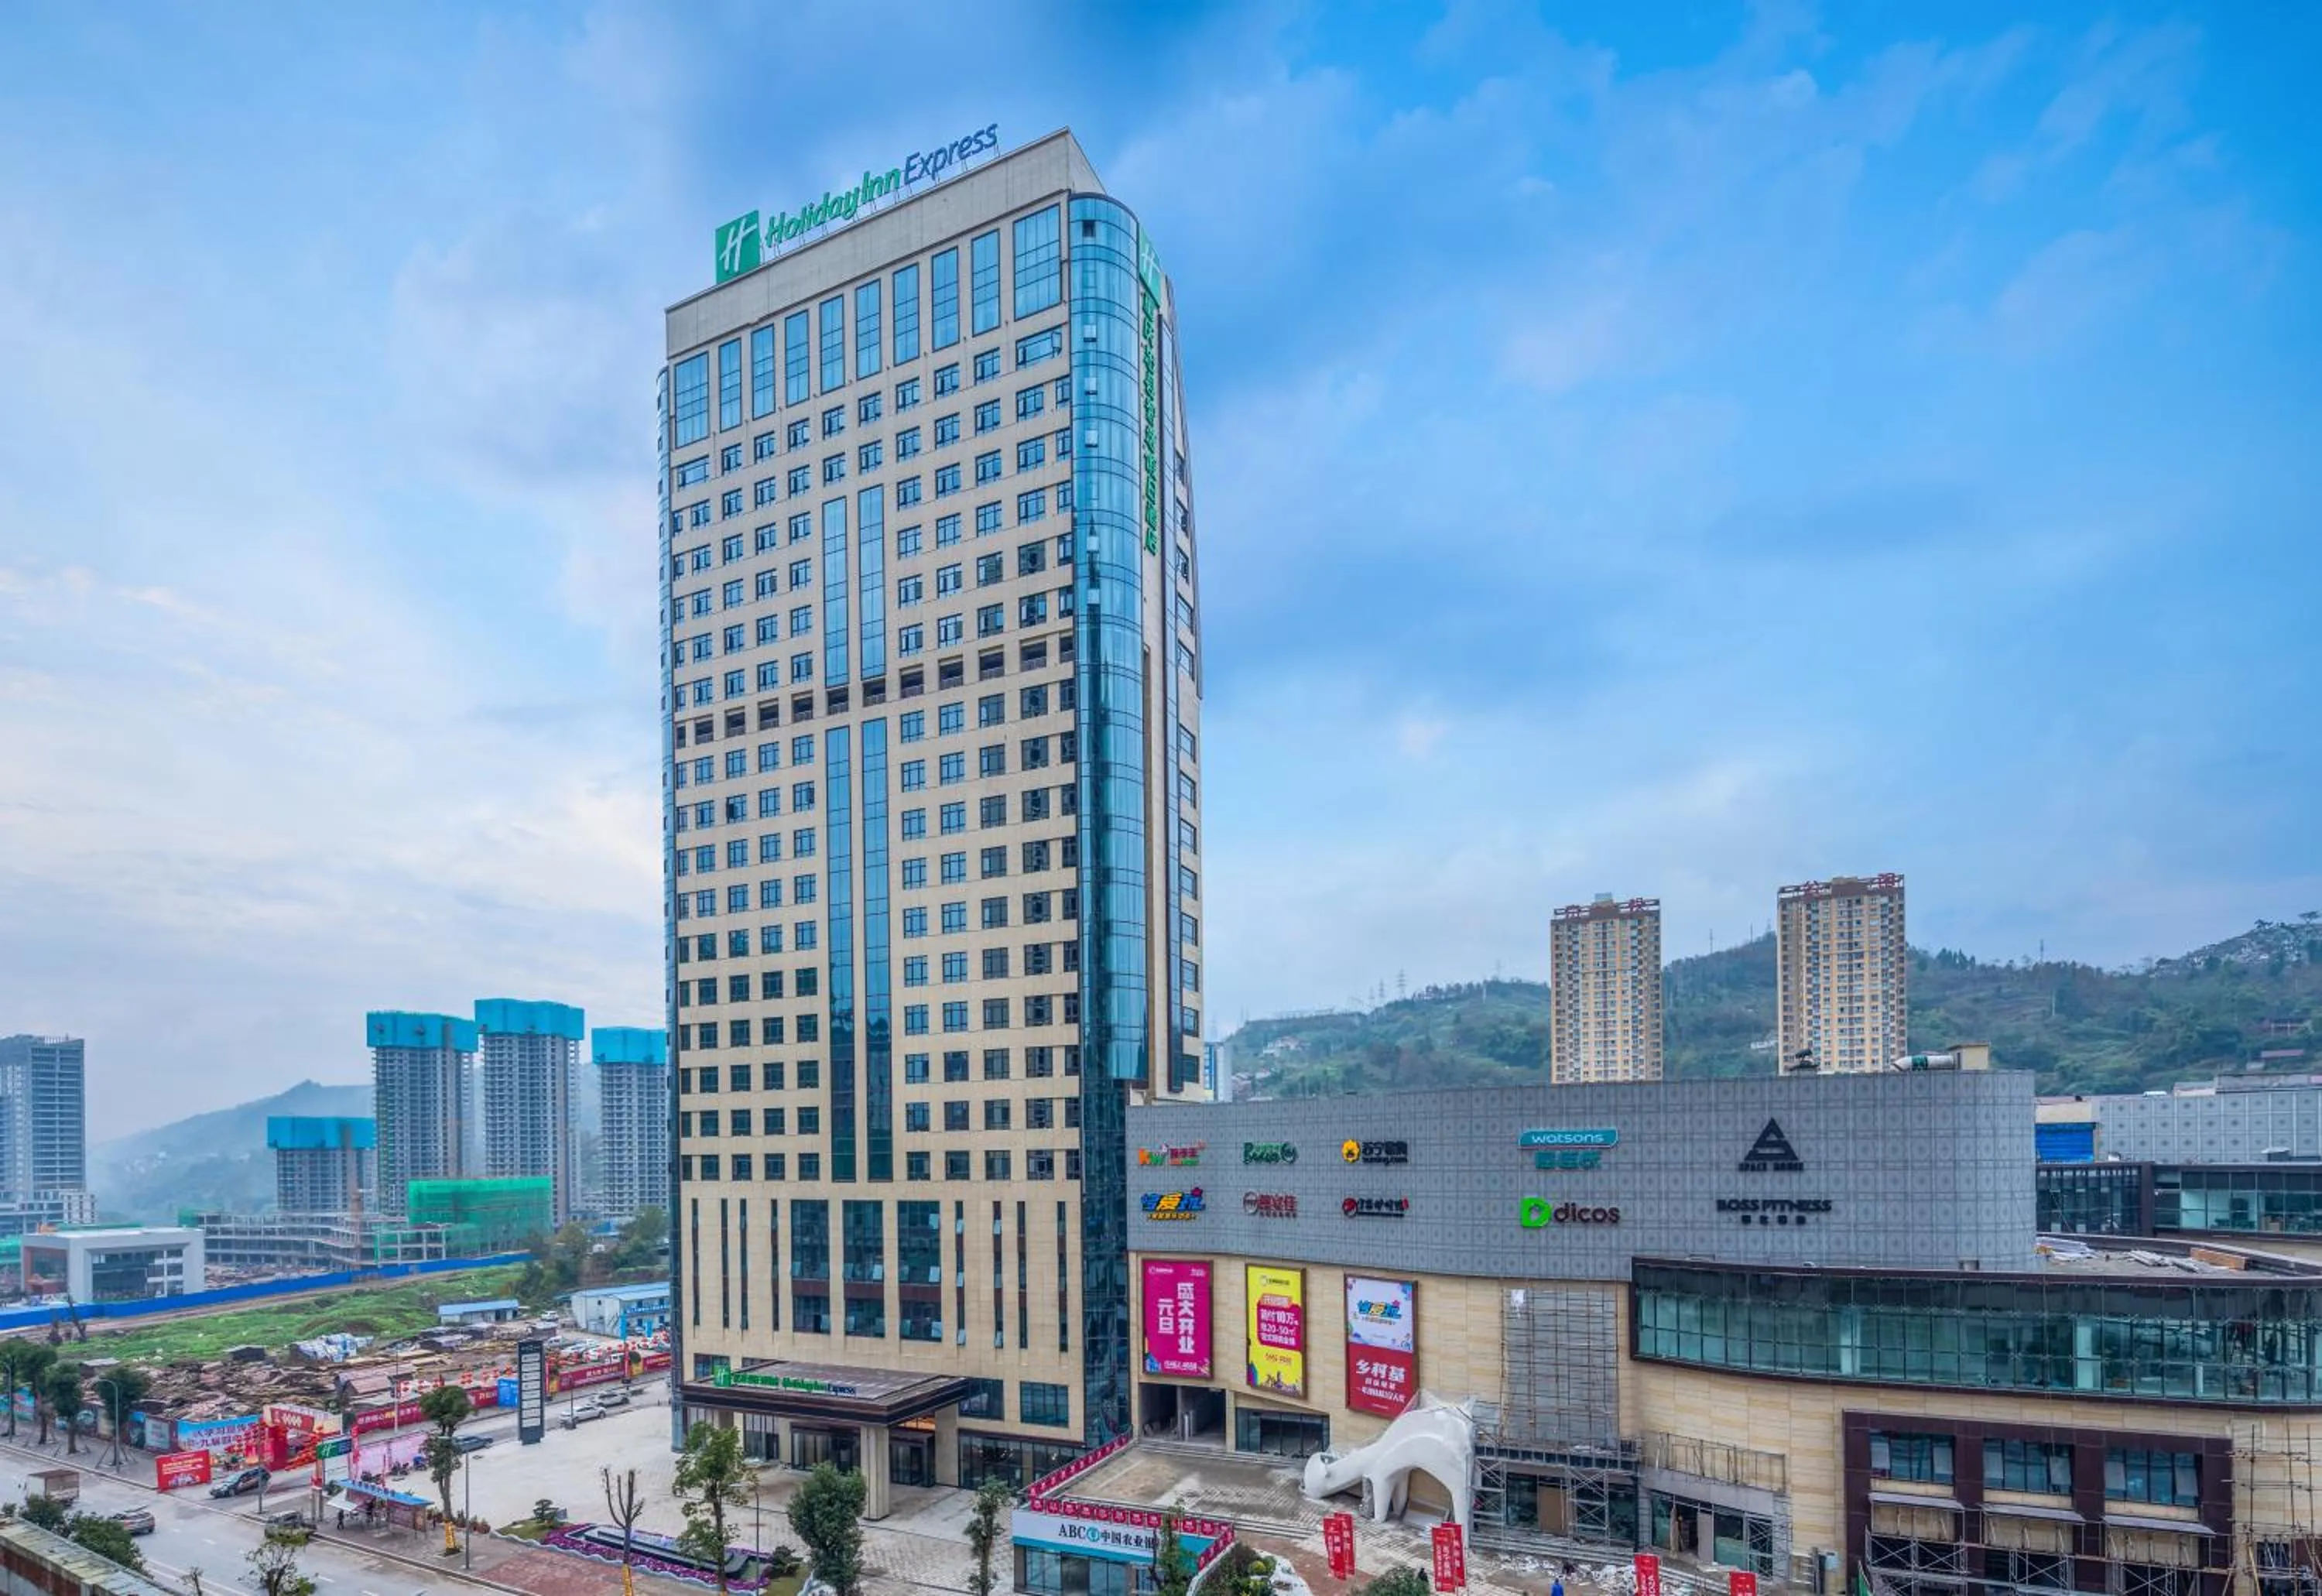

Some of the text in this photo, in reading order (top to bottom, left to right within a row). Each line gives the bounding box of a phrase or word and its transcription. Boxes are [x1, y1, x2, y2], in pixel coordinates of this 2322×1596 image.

[904, 123, 998, 186] Express
[1532, 1133, 1605, 1143] watsons
[1553, 1202, 1620, 1223] dicos
[1717, 1200, 1759, 1211] BOSS
[1157, 1298, 1175, 1334] 元旦
[1059, 1523, 1085, 1539] ABC
